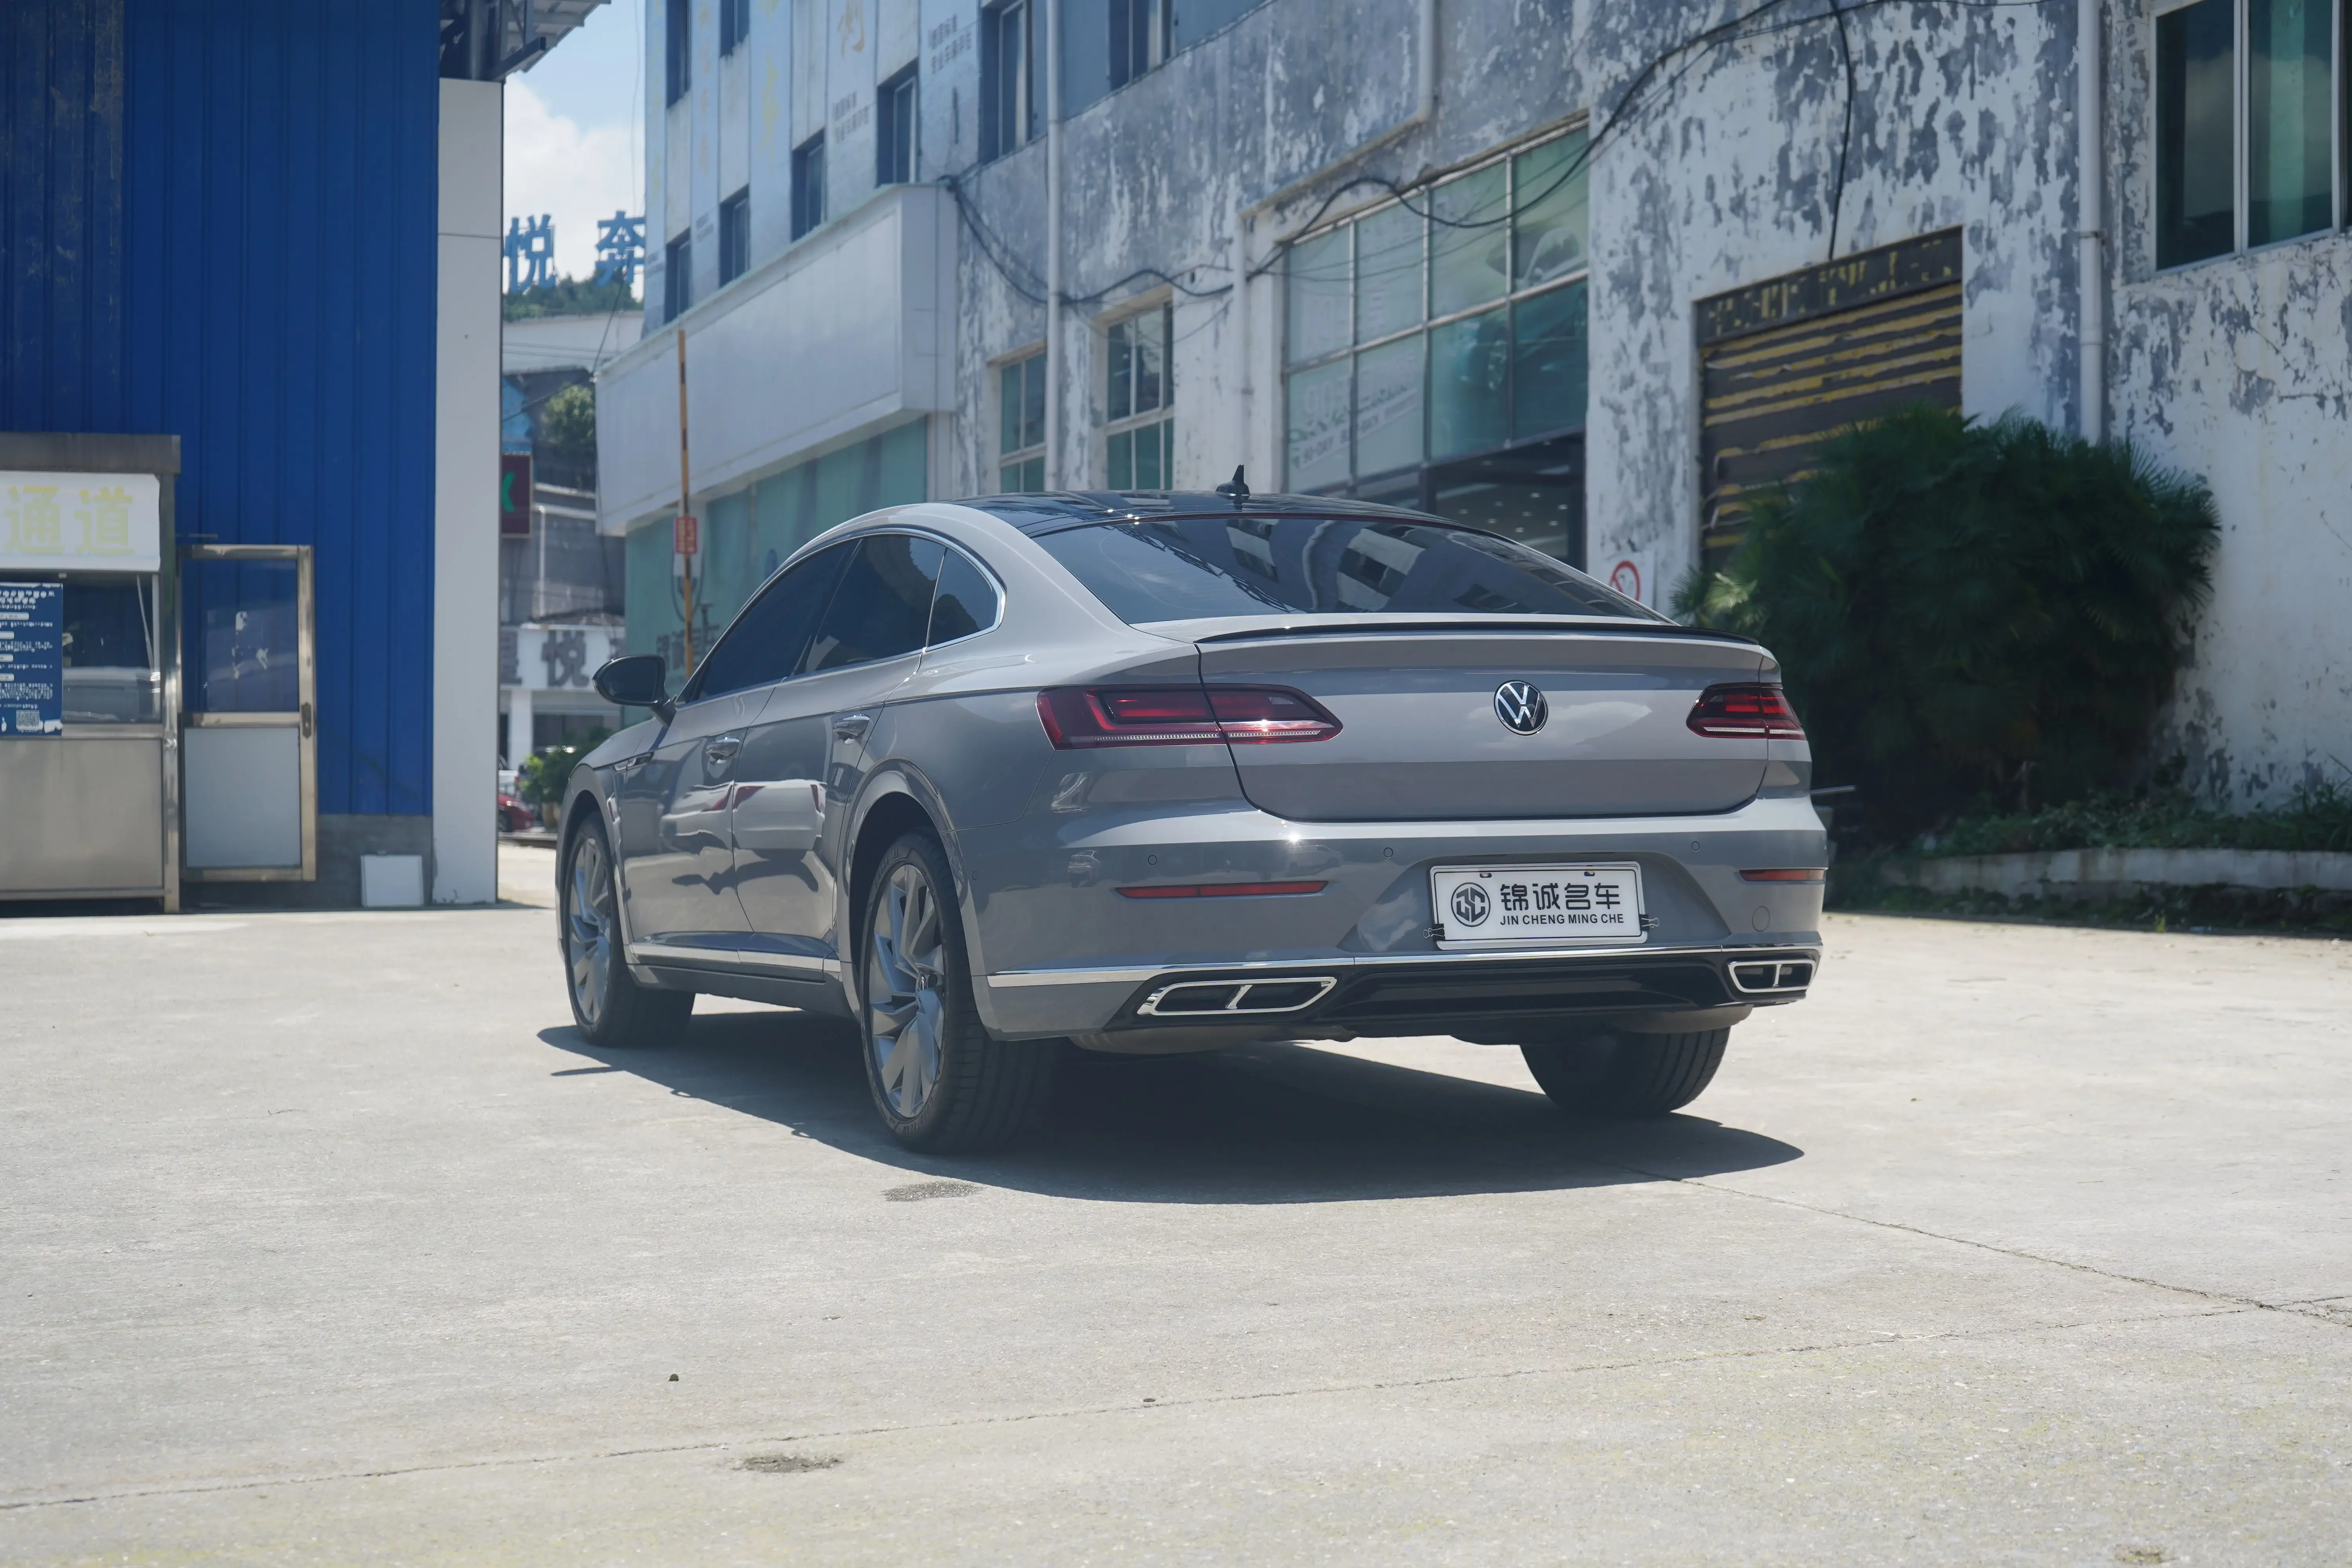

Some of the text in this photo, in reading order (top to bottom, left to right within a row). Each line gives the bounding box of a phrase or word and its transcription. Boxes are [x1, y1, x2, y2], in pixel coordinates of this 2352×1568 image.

[3, 485, 134, 557] 通道
[1500, 882, 1621, 911] 锦诚名车
[1500, 914, 1624, 925] JIN CHENG MING CHE
